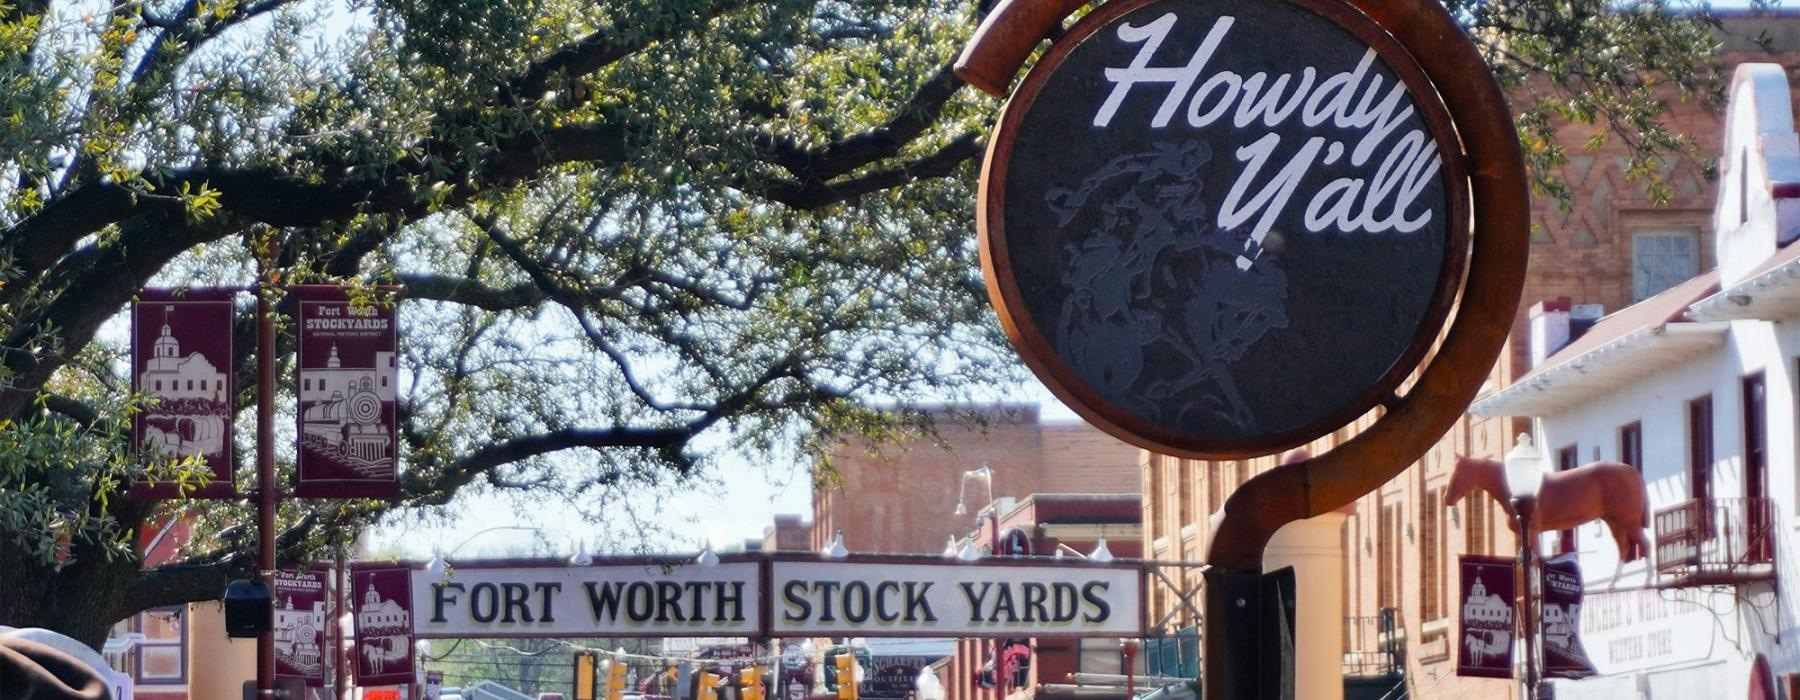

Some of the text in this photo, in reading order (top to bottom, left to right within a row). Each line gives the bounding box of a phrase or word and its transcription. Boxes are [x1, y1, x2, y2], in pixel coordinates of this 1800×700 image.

[1093, 12, 1414, 166] Howdy
[1217, 130, 1442, 271] Y'all
[306, 318, 388, 329] STOCKYARDS
[318, 305, 378, 317] Fort Wth
[430, 580, 747, 623] FORT WORTH
[783, 579, 1112, 623] STOCK YARDS
[1608, 628, 1673, 664] WESTERN STORE
